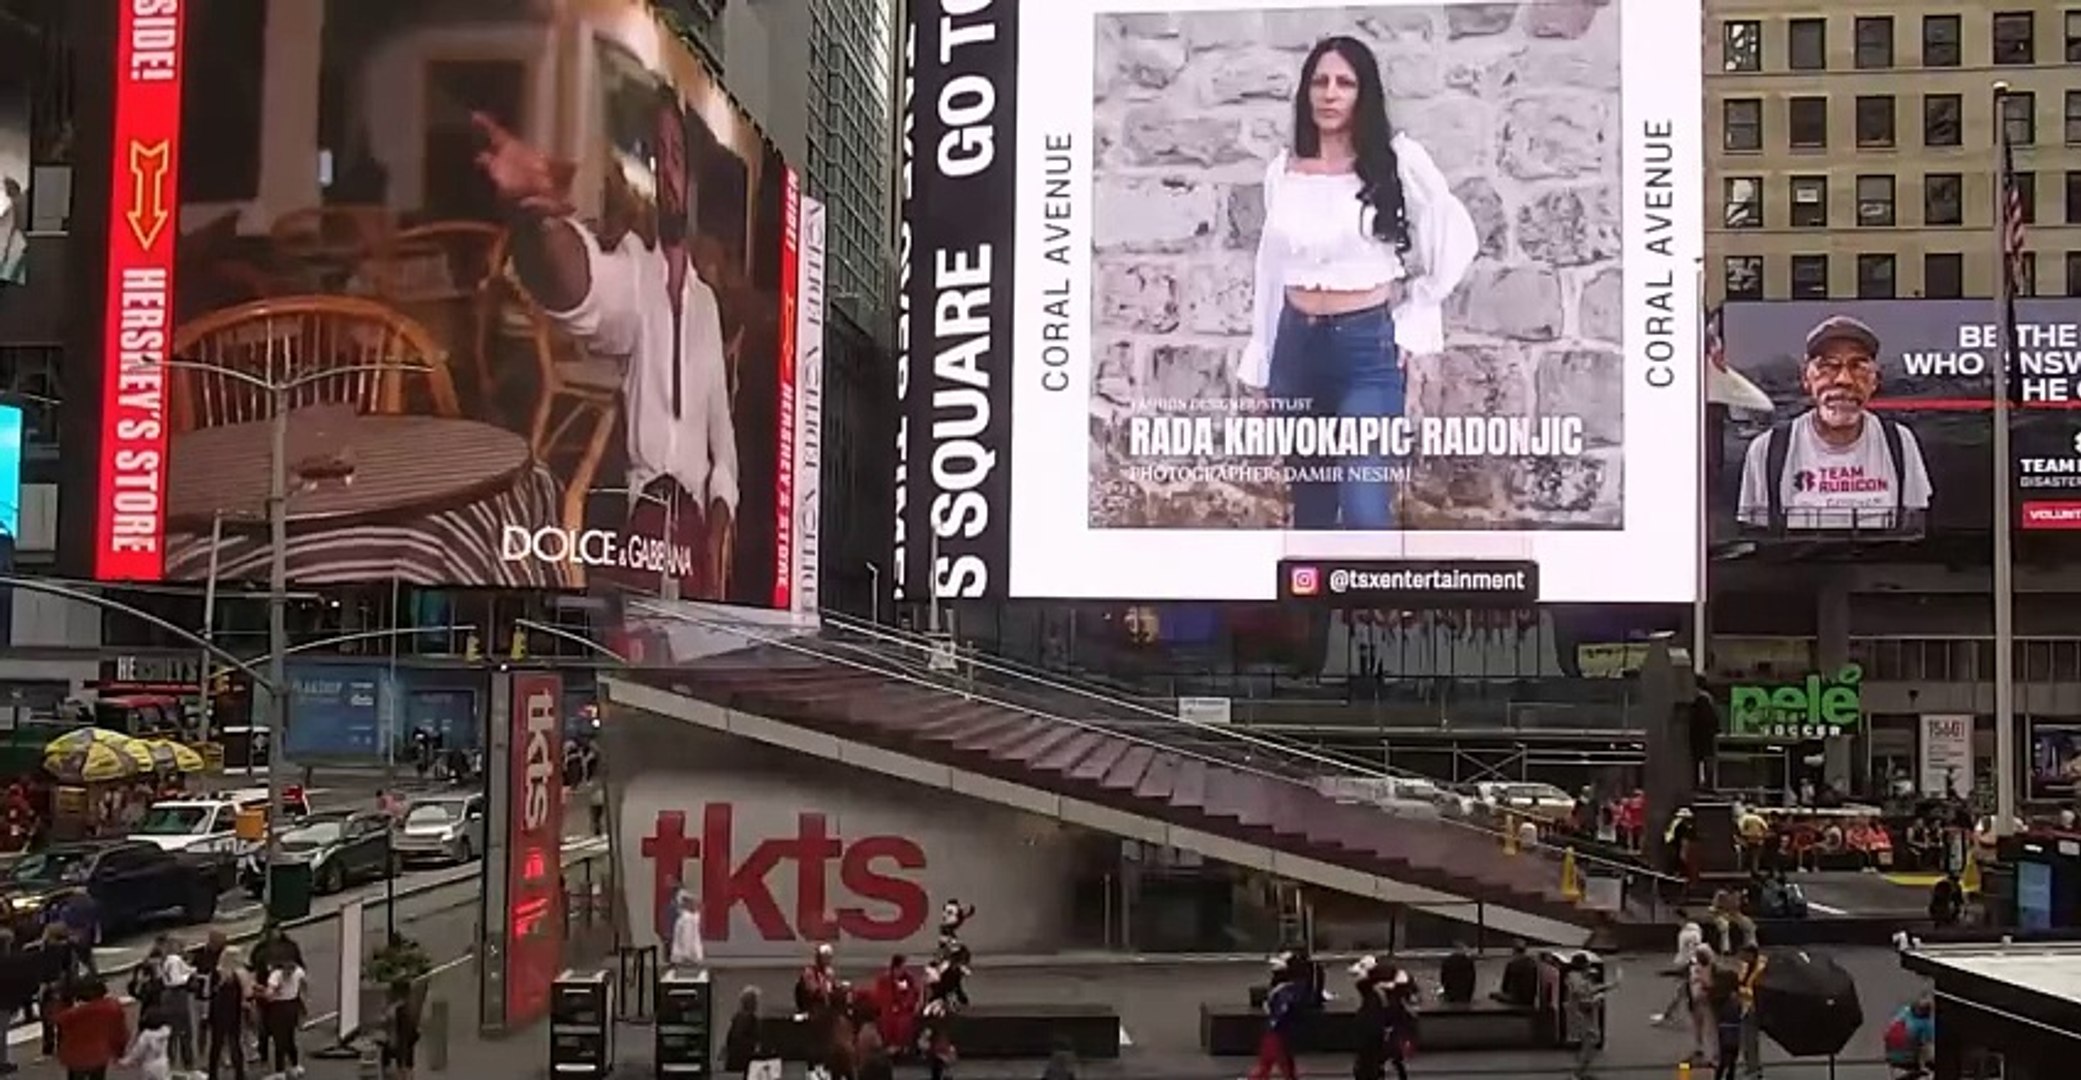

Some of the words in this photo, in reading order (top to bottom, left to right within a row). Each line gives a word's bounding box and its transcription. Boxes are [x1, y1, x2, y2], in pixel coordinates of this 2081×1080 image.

[937, 74, 996, 177] GO
[1043, 133, 1072, 265] AVENUE
[1644, 120, 1673, 256] AVENUE
[117, 268, 166, 440] HERSHEY'S
[1041, 279, 1070, 392] CORAL
[1645, 269, 1674, 389] CORAL
[1903, 353, 1984, 374] WHO
[1960, 325, 1997, 348] BE
[2016, 324, 2077, 348] THE
[931, 244, 995, 538] SQUARE
[1130, 417, 1214, 456] RADA
[1224, 417, 1411, 456] KRIVOKAPIC
[1422, 417, 1584, 456] RADONJIC
[1284, 466, 1343, 483] DAMIR
[1348, 466, 1411, 483] NESIMI
[1819, 466, 1864, 480] TEAM
[2020, 459, 2075, 472] TEAM
[113, 451, 158, 552] STORE
[1819, 479, 1888, 493] RUBICON
[502, 525, 617, 565] DOLCE
[1330, 569, 1525, 593] @tsxentertainment
[1730, 663, 1862, 735] pelé
[523, 688, 555, 831] tkts
[642, 803, 928, 941] tkts
